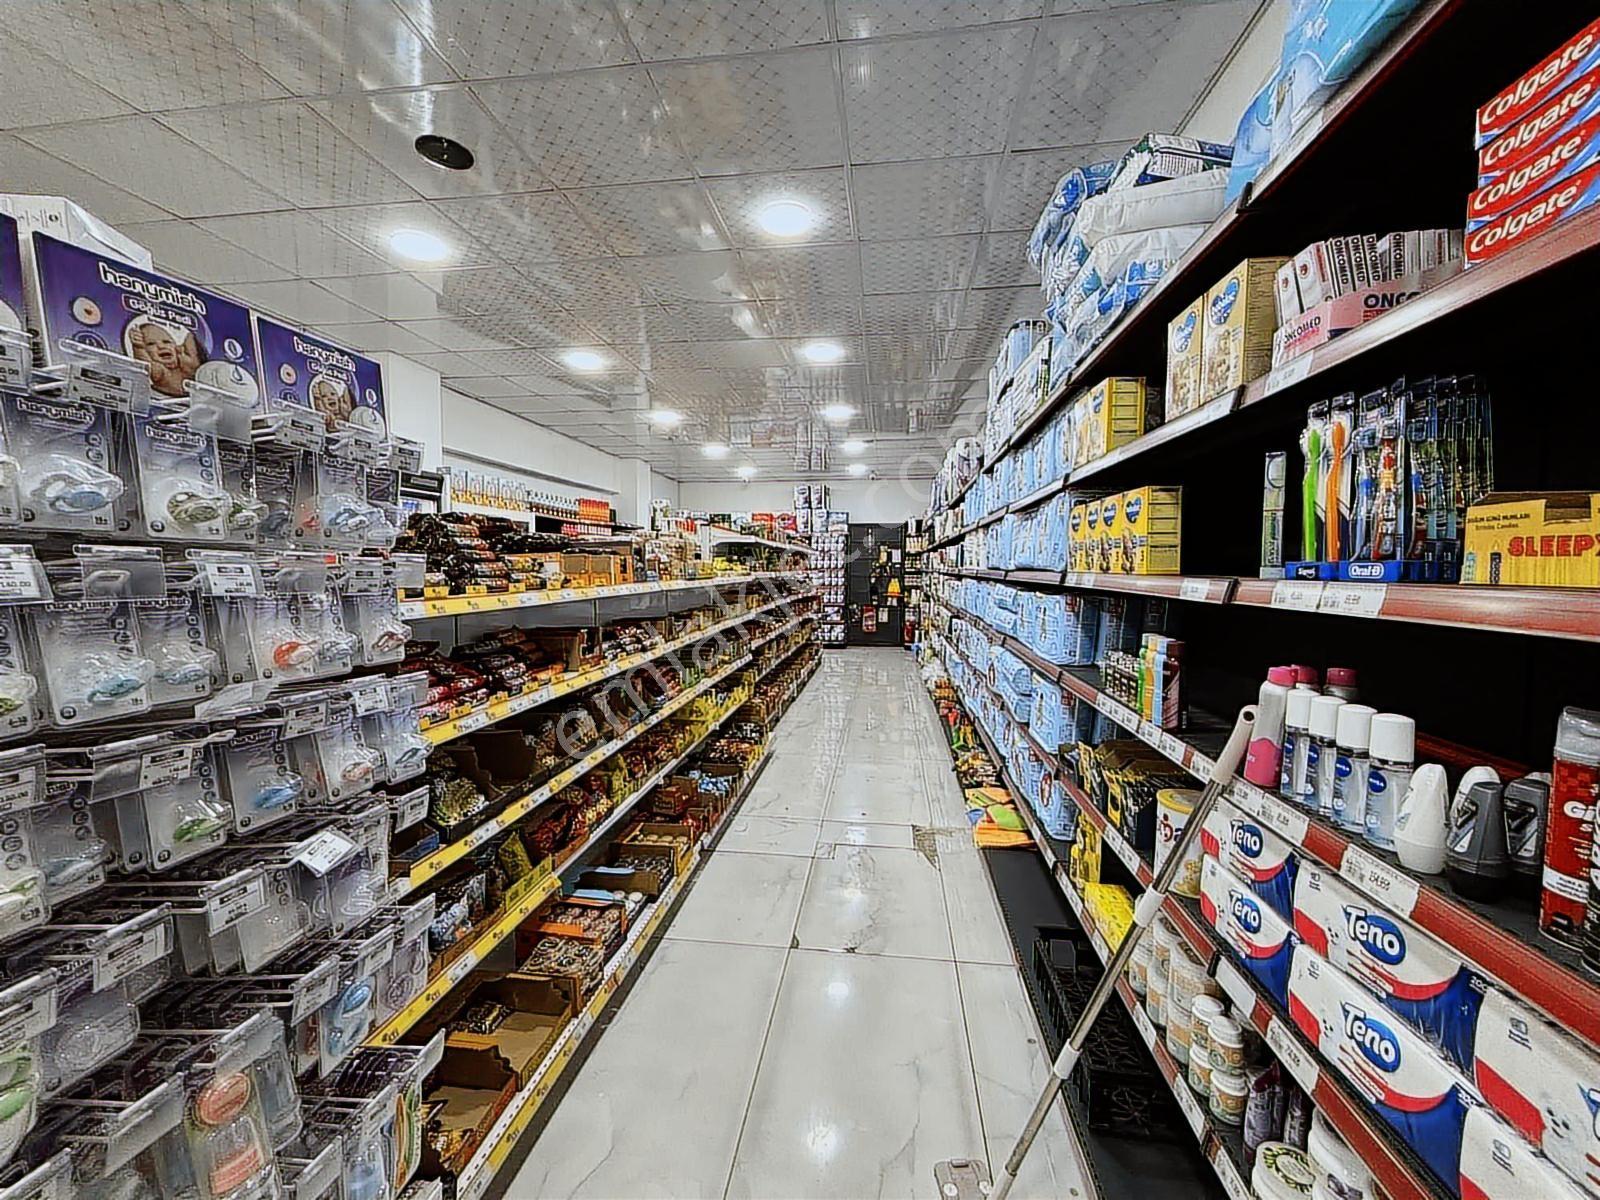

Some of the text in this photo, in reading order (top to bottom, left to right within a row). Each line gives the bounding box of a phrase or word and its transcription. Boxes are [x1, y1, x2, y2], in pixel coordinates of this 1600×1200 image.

[1481, 33, 1593, 125] Colgate
[1483, 81, 1592, 166] Colgate
[1473, 135, 1583, 210] Colgate
[1470, 185, 1579, 252] Colgate
[1334, 240, 1349, 284] ONCOMED
[1351, 237, 1365, 282] ONCOMED
[1366, 236, 1380, 281] ONCOMED
[1508, 534, 1600, 557] SLEEP
[1351, 565, 1380, 576] Oral-B
[1231, 819, 1260, 850] Teno
[1229, 889, 1260, 924] Teno
[1345, 904, 1400, 956] Teno
[1344, 1002, 1396, 1063] Teno
